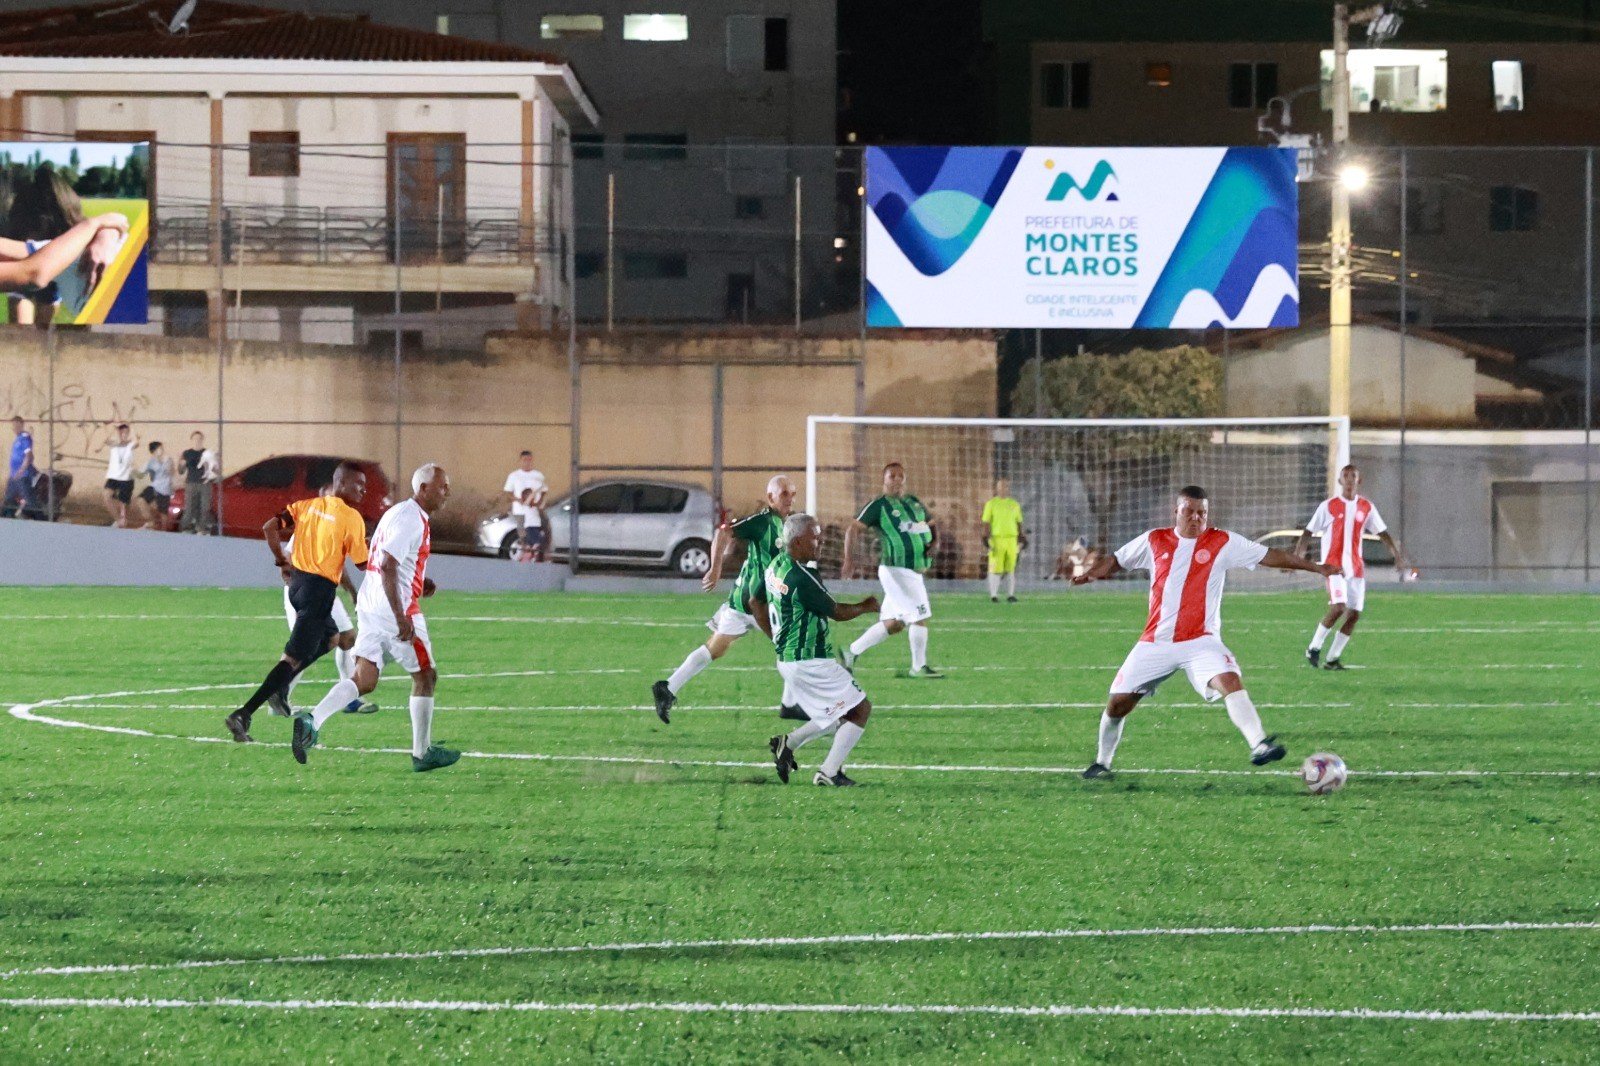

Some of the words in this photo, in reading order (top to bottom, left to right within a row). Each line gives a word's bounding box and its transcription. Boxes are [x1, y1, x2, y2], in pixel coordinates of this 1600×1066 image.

[1025, 216, 1114, 229] PREFEITURA
[1119, 216, 1138, 229] DE
[1026, 233, 1138, 252] MONTES
[1026, 256, 1138, 276] CLAROS
[1025, 294, 1065, 305] CIDADE
[1069, 294, 1138, 305] INTELIGENTE
[1049, 307, 1055, 318] E
[1058, 307, 1114, 318] INCLUSIVA
